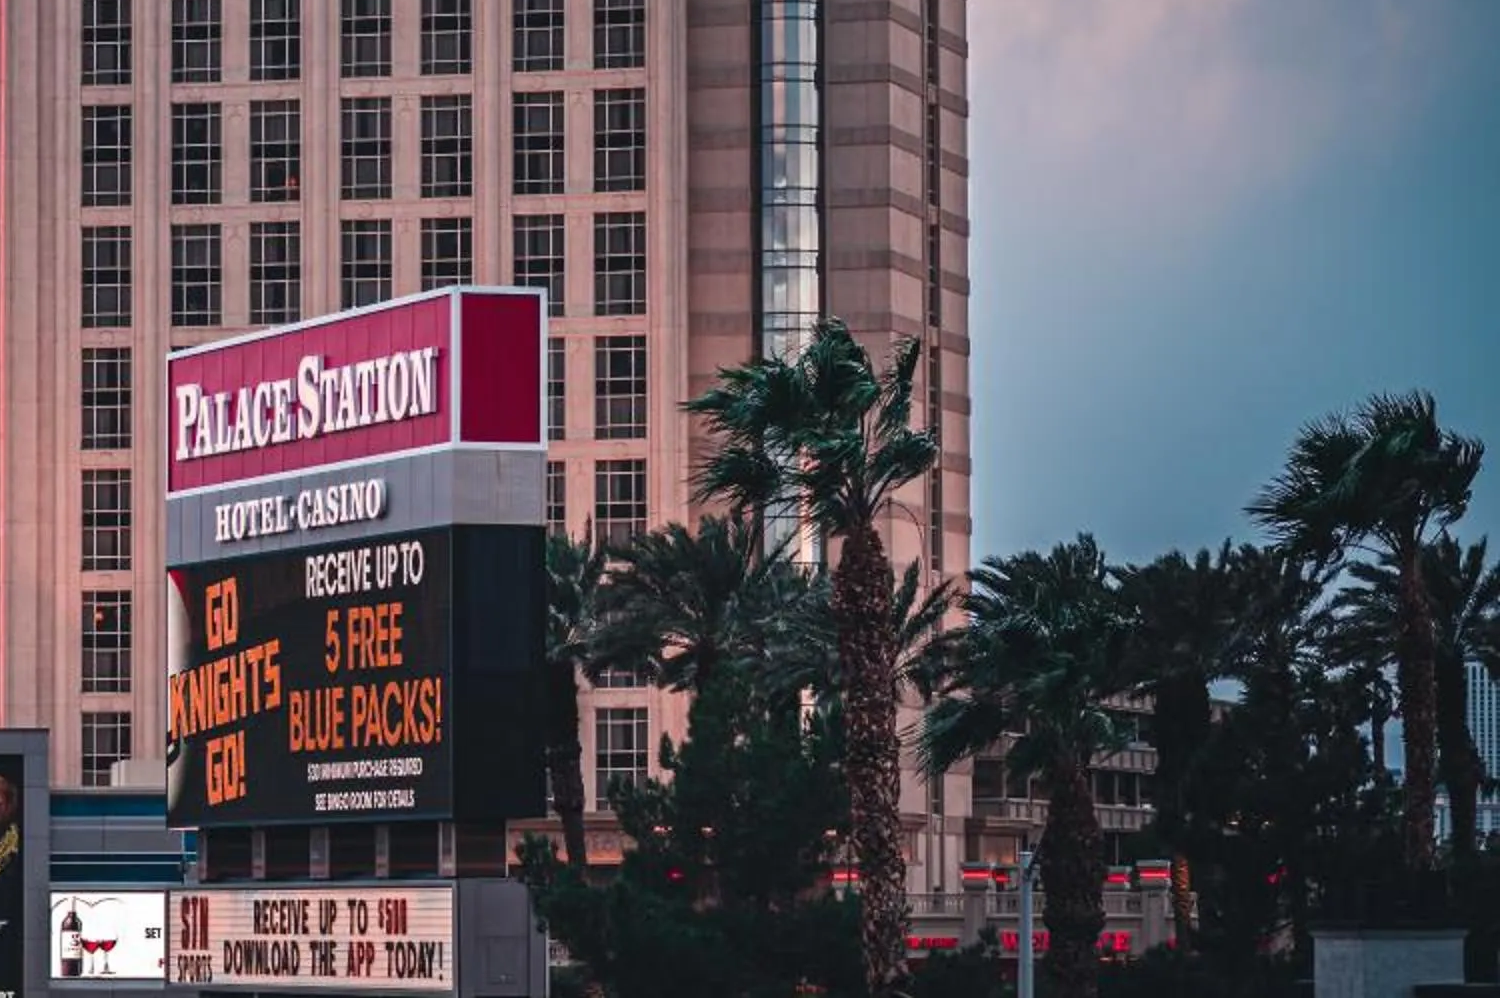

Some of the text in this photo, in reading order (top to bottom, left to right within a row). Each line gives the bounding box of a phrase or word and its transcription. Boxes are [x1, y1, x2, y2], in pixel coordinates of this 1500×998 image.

[176, 346, 438, 461] PALACE STATION
[305, 540, 424, 598] RECEIVE UP TO
[206, 576, 238, 650] GO
[325, 602, 404, 674] 5 FREE
[170, 638, 281, 740] KNIGHTS
[289, 677, 442, 752] BLUE PACKS!
[206, 730, 246, 806] GO!
[180, 896, 209, 950] STN
[253, 899, 310, 935] RECEIVE
[318, 899, 337, 935] UP
[347, 899, 368, 935] TO
[177, 954, 213, 983] SPORTS
[223, 940, 443, 981] DOWNLOAD THE APP TODAY!
